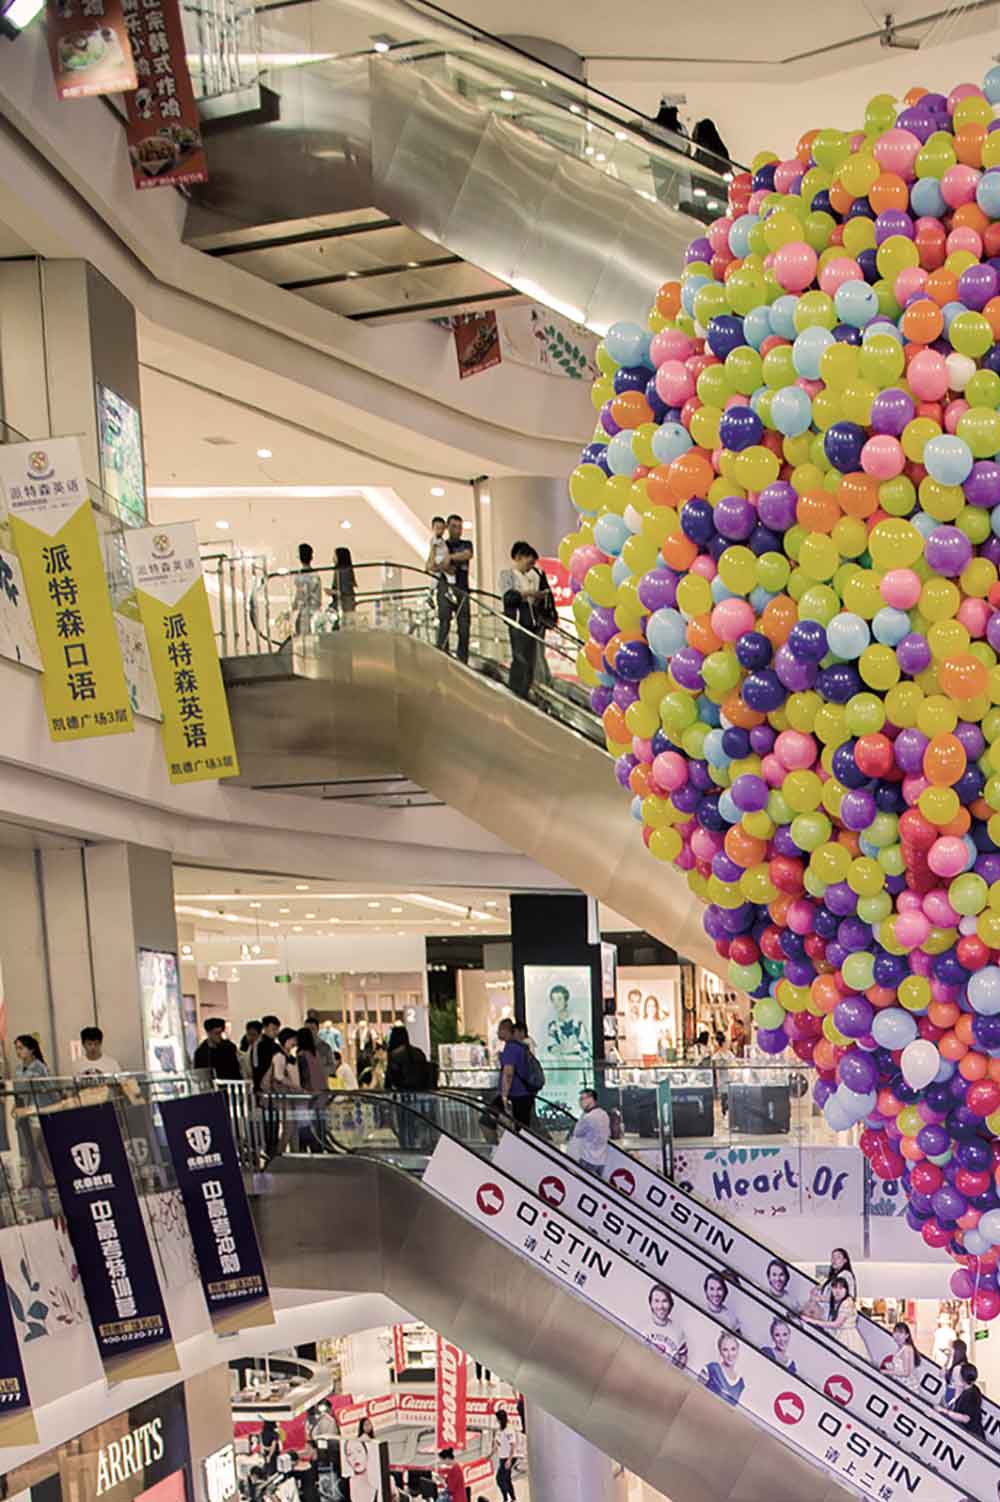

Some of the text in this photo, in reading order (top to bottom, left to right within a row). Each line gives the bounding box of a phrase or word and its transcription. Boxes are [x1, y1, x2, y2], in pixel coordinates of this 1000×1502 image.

[42, 543, 97, 701] 派特森口语
[52, 708, 129, 732] 凯德广场3层
[162, 613, 207, 749] 派特森英语
[712, 1159, 799, 1201] Heart
[96, 1416, 165, 1497] ARRITS
